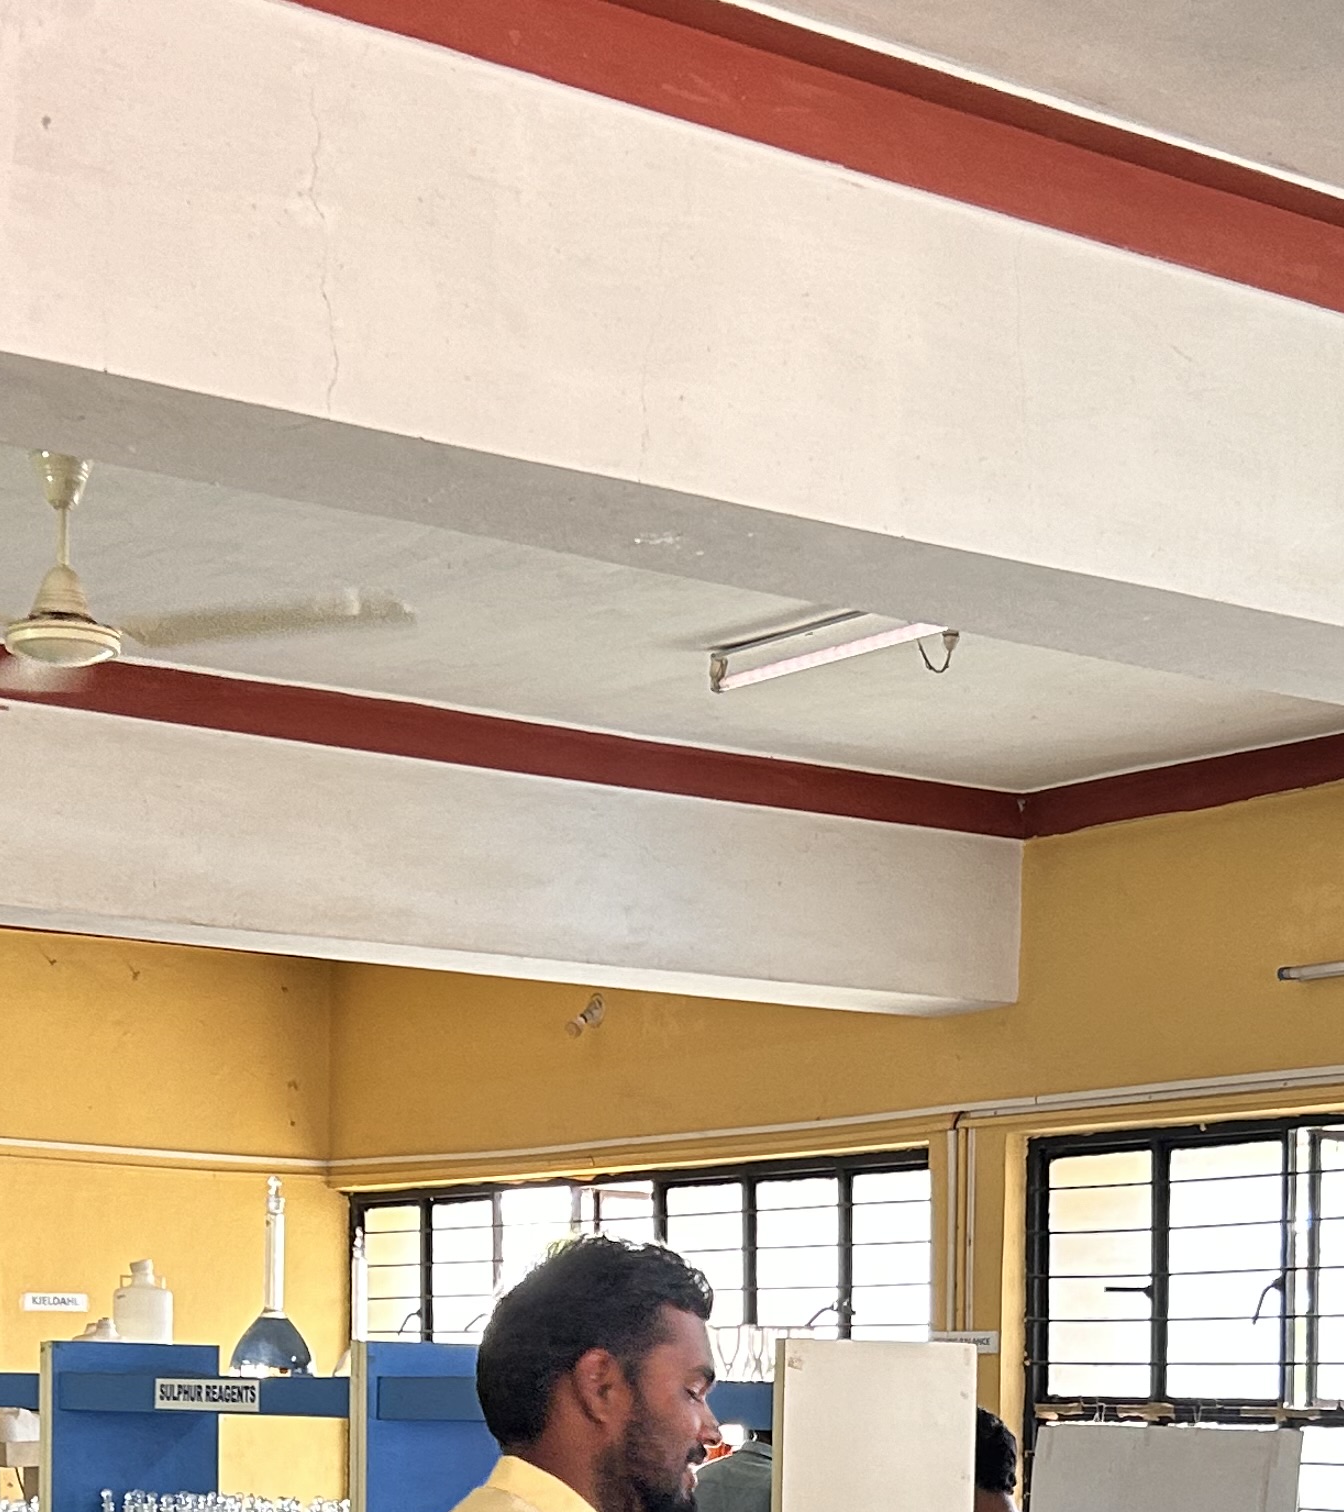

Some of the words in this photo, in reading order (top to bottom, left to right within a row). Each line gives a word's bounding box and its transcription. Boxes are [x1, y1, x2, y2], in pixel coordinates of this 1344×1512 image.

[31, 1295, 79, 1306] KJELDAHL
[160, 1384, 203, 1402] SULPHUR
[205, 1385, 256, 1403] REAGENTS
